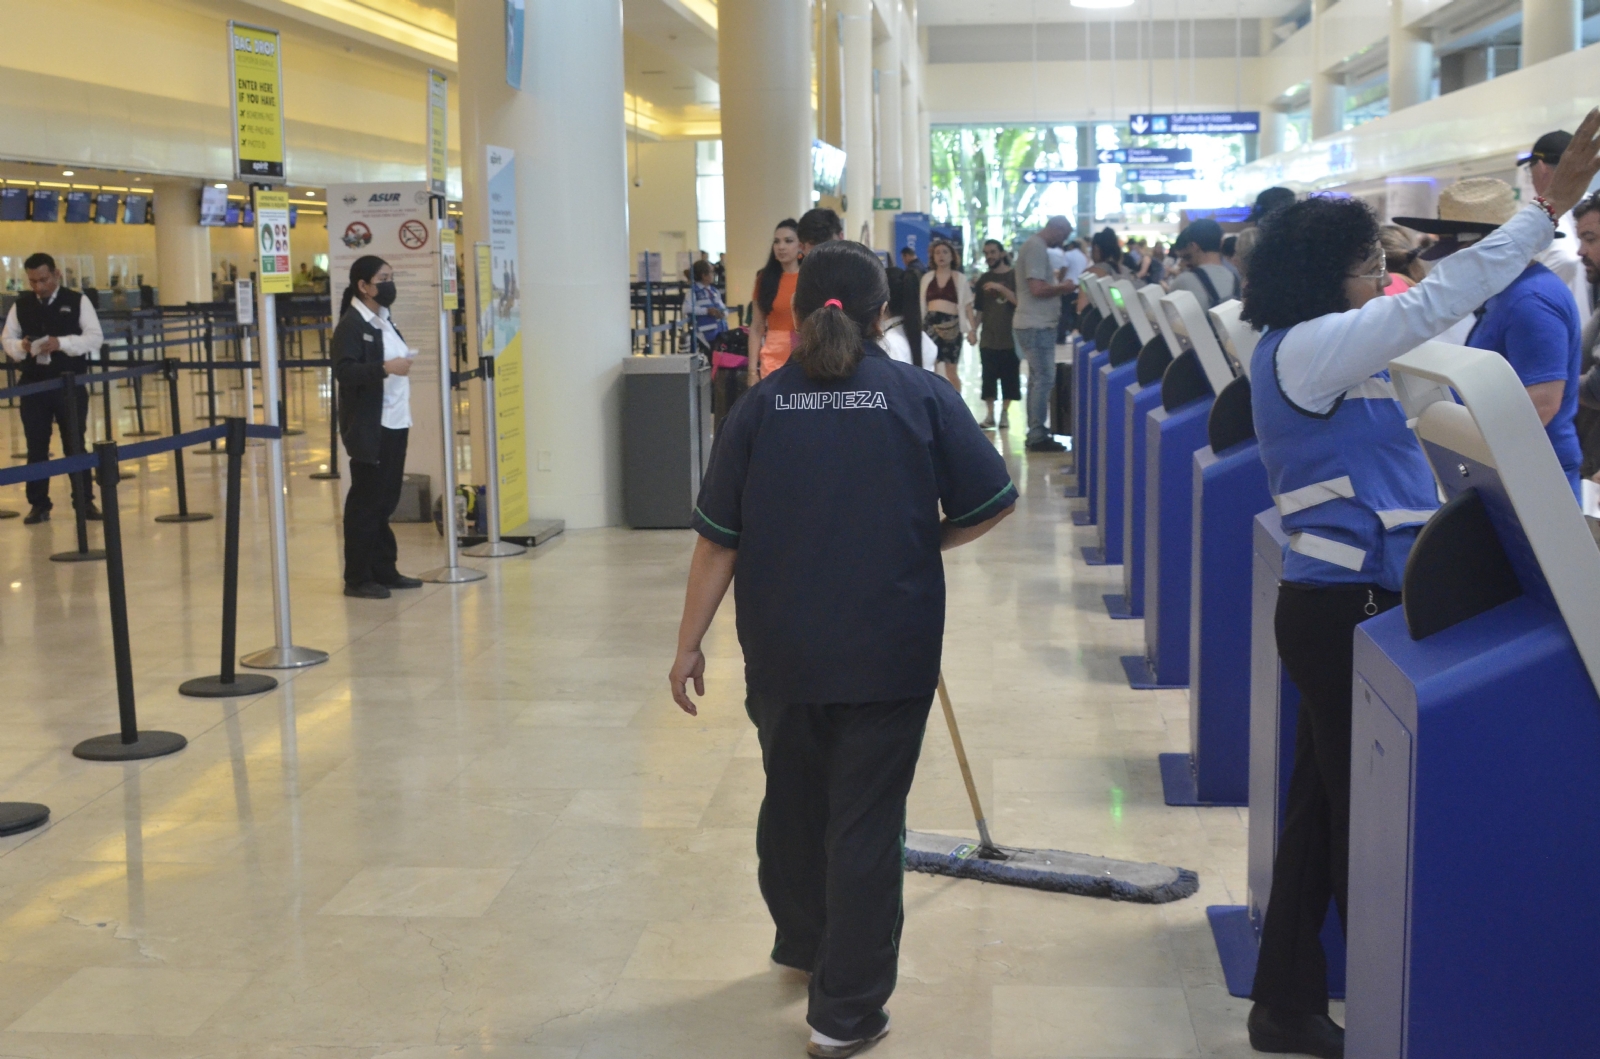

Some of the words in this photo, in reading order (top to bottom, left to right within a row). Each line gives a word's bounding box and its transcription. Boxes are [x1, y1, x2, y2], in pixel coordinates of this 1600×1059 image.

[234, 34, 252, 53] BAG
[254, 39, 275, 57] DROP
[238, 78, 257, 91] ENTER
[259, 82, 273, 93] HERE
[239, 92, 244, 102] IF
[247, 93, 259, 104] YOU
[252, 161, 269, 171] spirit
[368, 192, 401, 202] ASUR
[775, 390, 888, 410] LIMPIEZA
